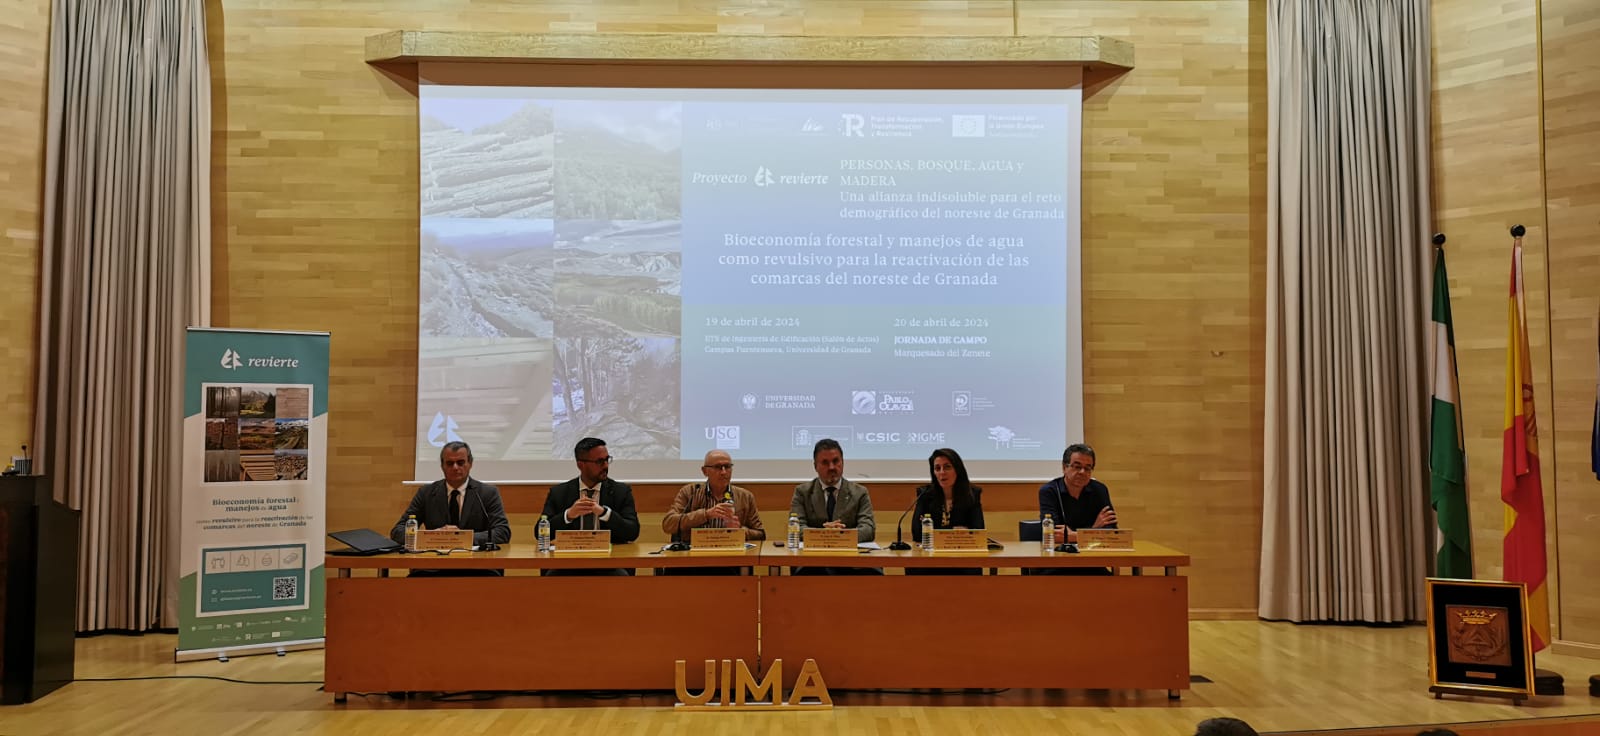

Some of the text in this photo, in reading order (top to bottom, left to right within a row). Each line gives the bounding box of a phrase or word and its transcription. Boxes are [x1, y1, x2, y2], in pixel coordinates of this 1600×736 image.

[978, 160, 1014, 171] AGUA
[692, 171, 748, 188] Proyecto
[779, 172, 829, 185] revierte
[840, 176, 897, 187] MADERA
[840, 191, 1062, 206] Una alianza indisoluble para el reto
[840, 207, 1065, 221] demográfico del noreste de Granada
[724, 232, 1025, 250] Bioeconomía forestal y manejos de agua
[718, 252, 1030, 270] como revulsivo para la reactivación de las
[750, 272, 998, 286] comarcas del noreste de Granada
[705, 316, 800, 327] 19 de abril de 2024
[893, 317, 989, 328] 20 de abril de 2024
[894, 336, 988, 345] JORNADA DE CAMPO
[947, 348, 960, 359] del
[248, 356, 299, 368] revierte
[705, 427, 738, 440] USC
[865, 432, 901, 442] CSIC
[212, 497, 265, 506] Bioeconomía
[225, 504, 259, 512] manejos
[268, 504, 287, 512] agua
[675, 659, 832, 705] UIMA
